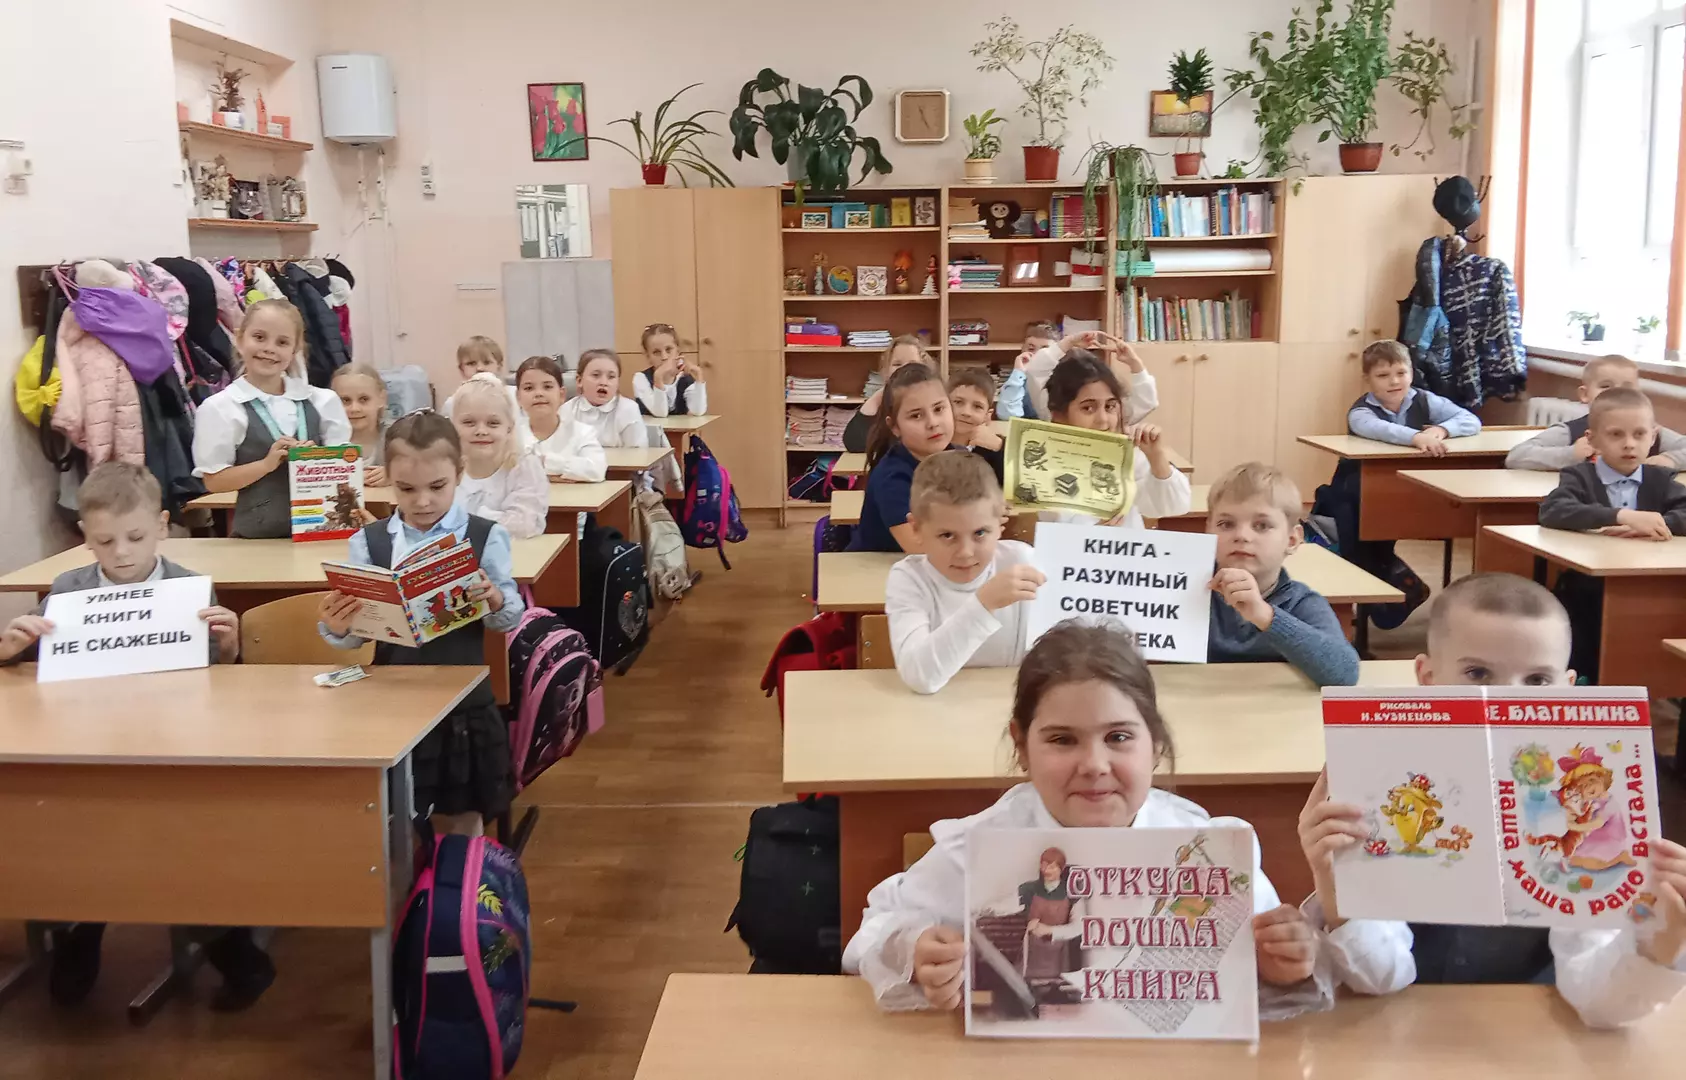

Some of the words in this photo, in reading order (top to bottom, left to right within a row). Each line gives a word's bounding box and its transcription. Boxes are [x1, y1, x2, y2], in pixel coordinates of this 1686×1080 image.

[1083, 538, 1157, 558] КНИГА
[1062, 566, 1188, 590] РАЗУМНЫЙ
[86, 588, 154, 604] УМНЕЕ
[1060, 596, 1180, 619] СОВЕТЧИК
[83, 609, 153, 625] КНИГИ
[52, 641, 80, 655] НЕ
[86, 630, 192, 652] СКАЖЕШЬ
[1067, 866, 1232, 897] ОТКУДА
[1081, 917, 1219, 947] ПОШЛА
